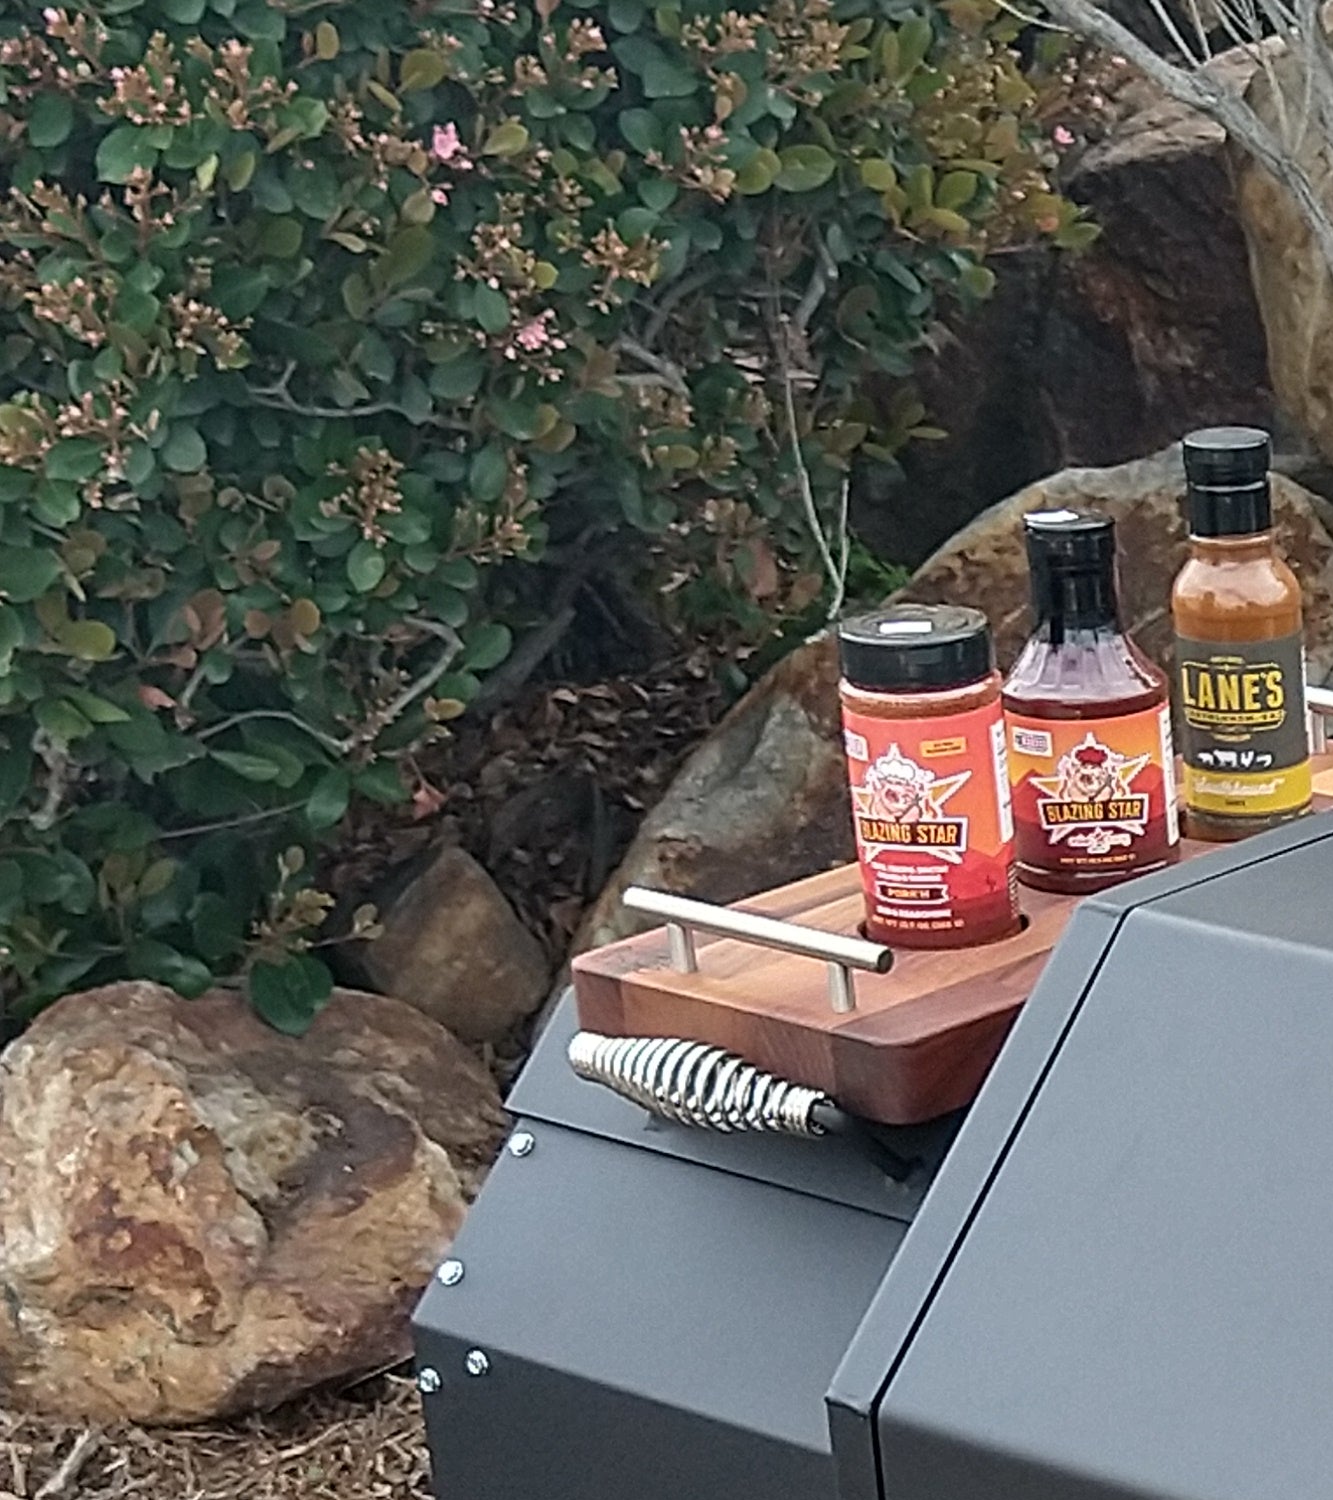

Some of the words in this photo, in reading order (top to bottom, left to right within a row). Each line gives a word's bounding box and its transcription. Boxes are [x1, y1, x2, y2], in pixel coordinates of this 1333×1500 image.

[1181, 666, 1285, 712] LANE'S
[1046, 803, 1104, 822] BLAZING
[1107, 801, 1142, 820] STAR
[860, 819, 911, 845] BLAZING
[916, 824, 958, 845] STAR
